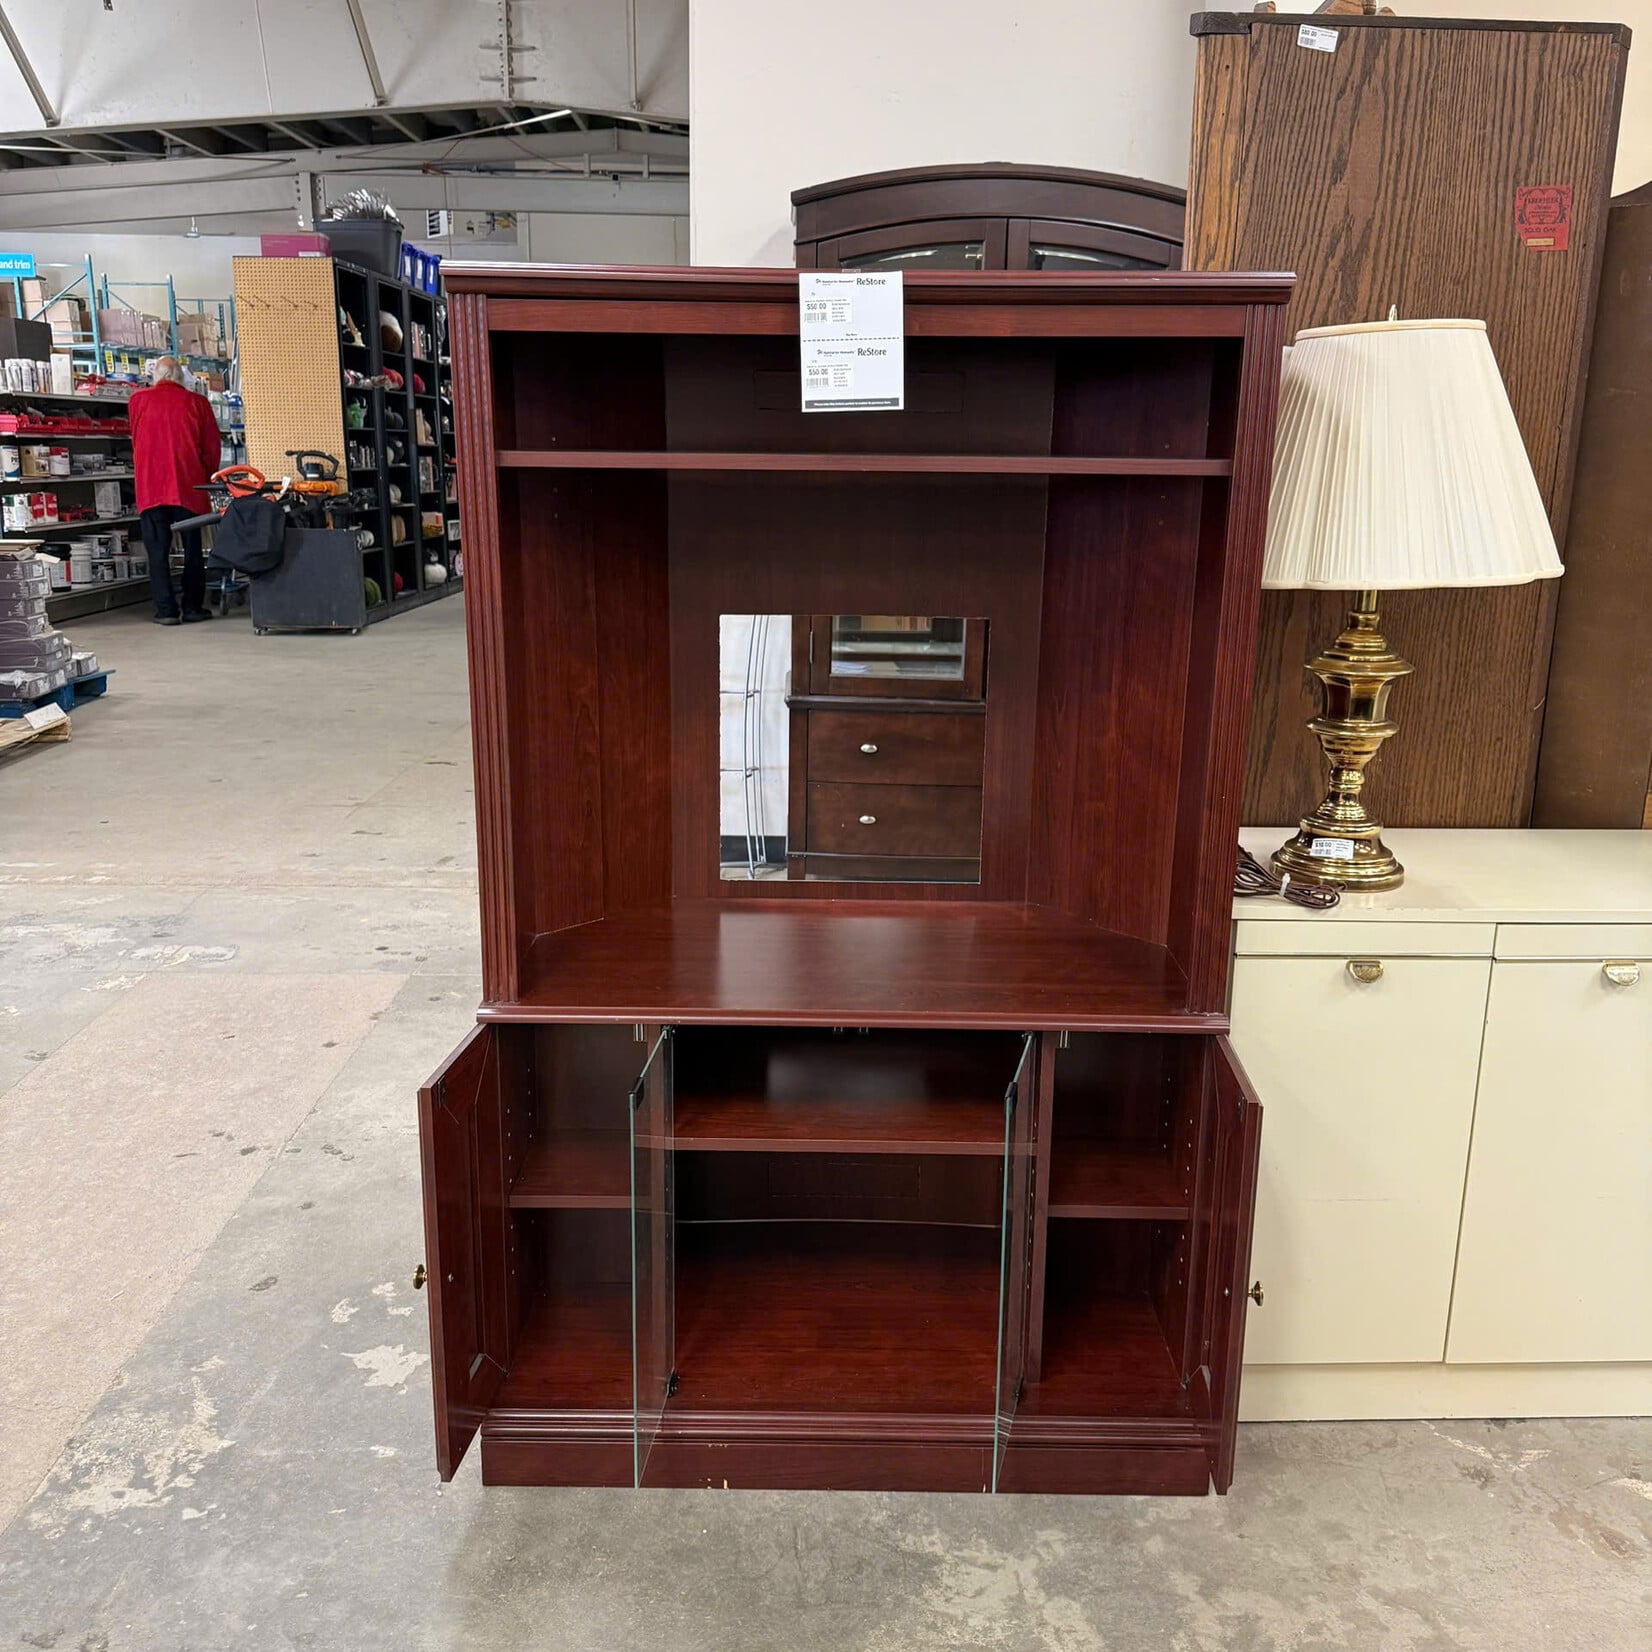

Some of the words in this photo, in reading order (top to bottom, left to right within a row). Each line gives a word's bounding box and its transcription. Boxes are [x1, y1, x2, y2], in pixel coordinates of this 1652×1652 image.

[14, 260, 30, 269] trim
[856, 277, 886, 286] ReStore
[857, 347, 887, 356] ReStore
